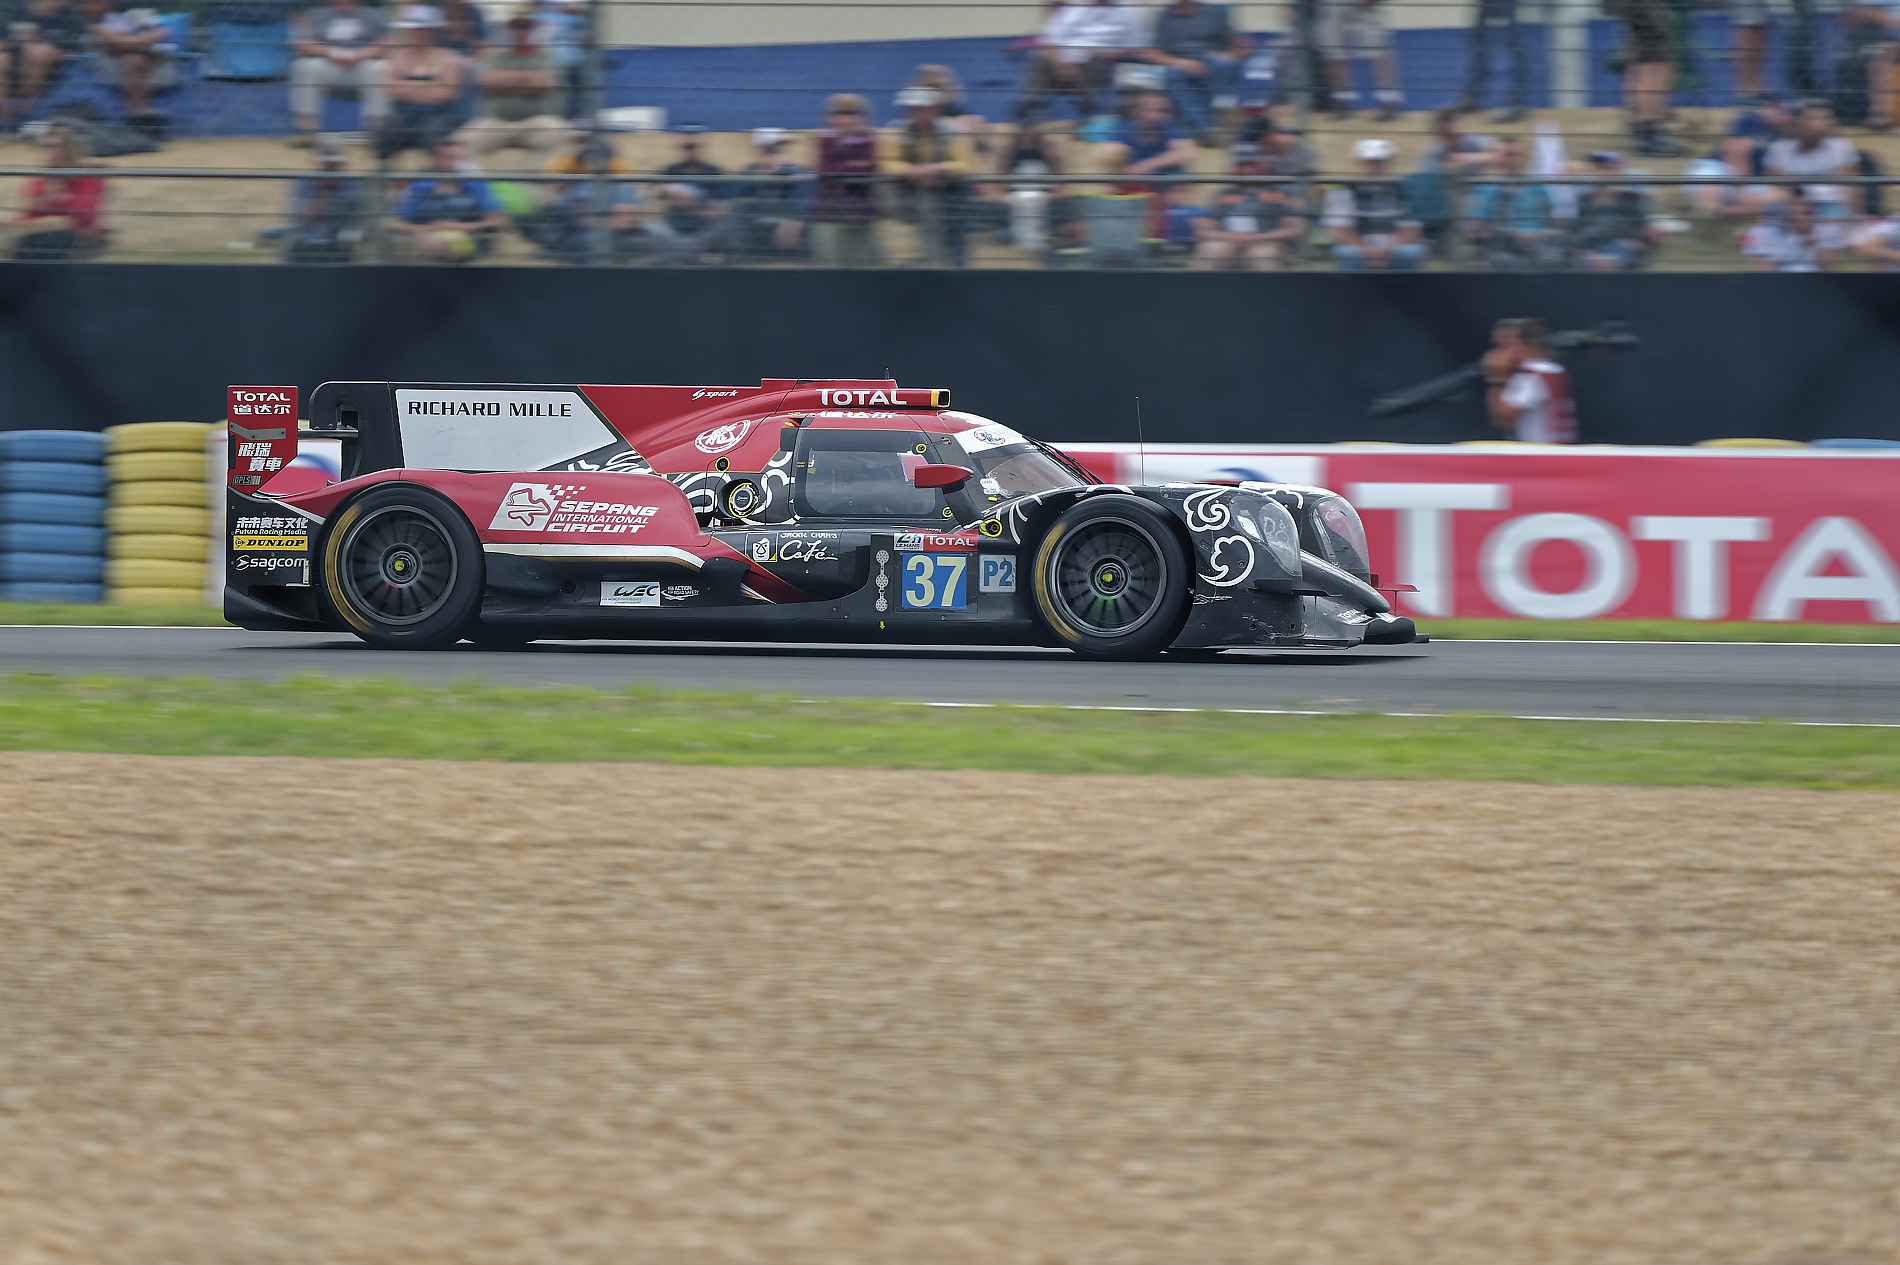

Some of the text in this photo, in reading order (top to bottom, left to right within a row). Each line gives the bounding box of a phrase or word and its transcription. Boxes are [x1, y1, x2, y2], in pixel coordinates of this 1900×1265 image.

[233, 391, 291, 402] TOTAL
[705, 390, 738, 398] spark
[816, 388, 907, 406] TOTAL
[408, 401, 572, 417] RICHARD MILLE
[558, 501, 659, 517] SEPANG
[552, 513, 649, 525] INTERNATIONAL
[546, 523, 646, 535] CIRCUIT
[246, 539, 304, 547] DUNLOP
[927, 535, 976, 547] TOTAL
[779, 539, 839, 562] Café
[249, 557, 305, 571] sagcom
[983, 559, 1014, 587] P2
[905, 555, 967, 608] 37
[614, 584, 659, 597] WEC
